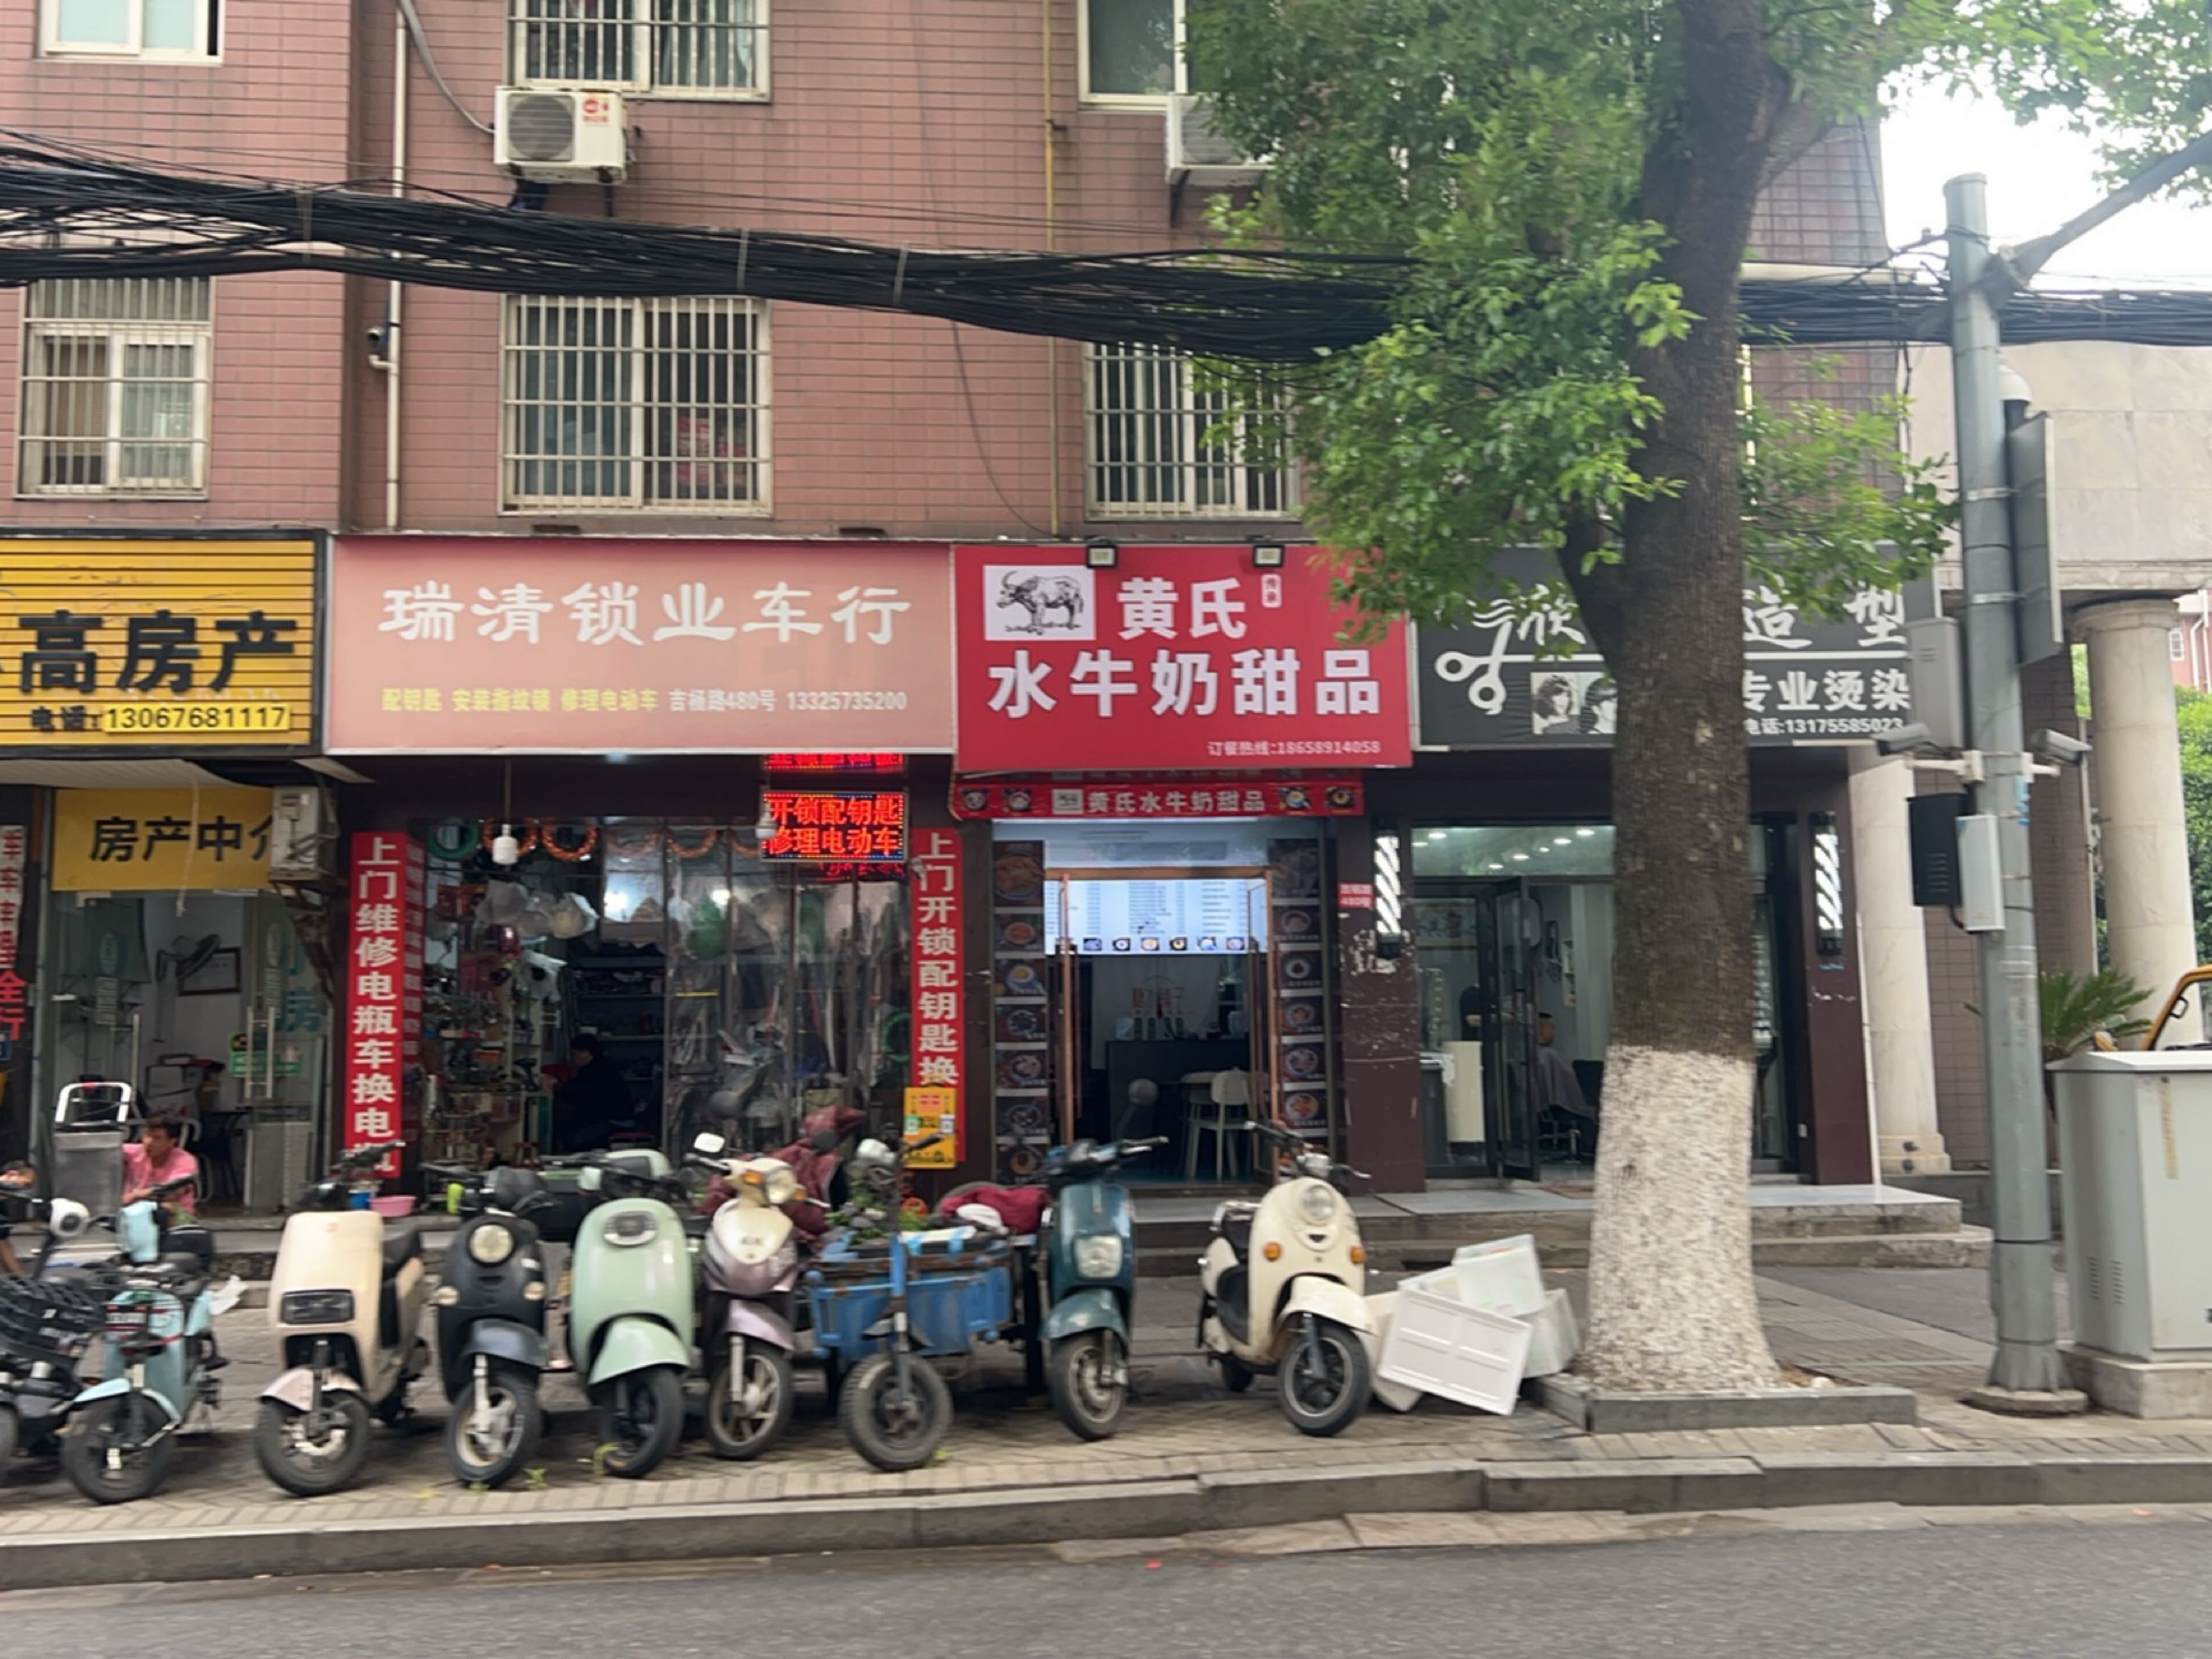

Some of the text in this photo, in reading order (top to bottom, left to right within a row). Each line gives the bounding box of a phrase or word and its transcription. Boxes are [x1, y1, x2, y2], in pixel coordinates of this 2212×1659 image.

[378, 580, 911, 646] 瑞清锁业车行
[1116, 576, 1247, 639] 黄氏
[987, 649, 1381, 718] 水牛奶甜品
[769, 797, 899, 826] 开锁配钥匙
[1087, 790, 1266, 813] 黄氏水牛奶甜品
[769, 825, 899, 856] 修理电动车
